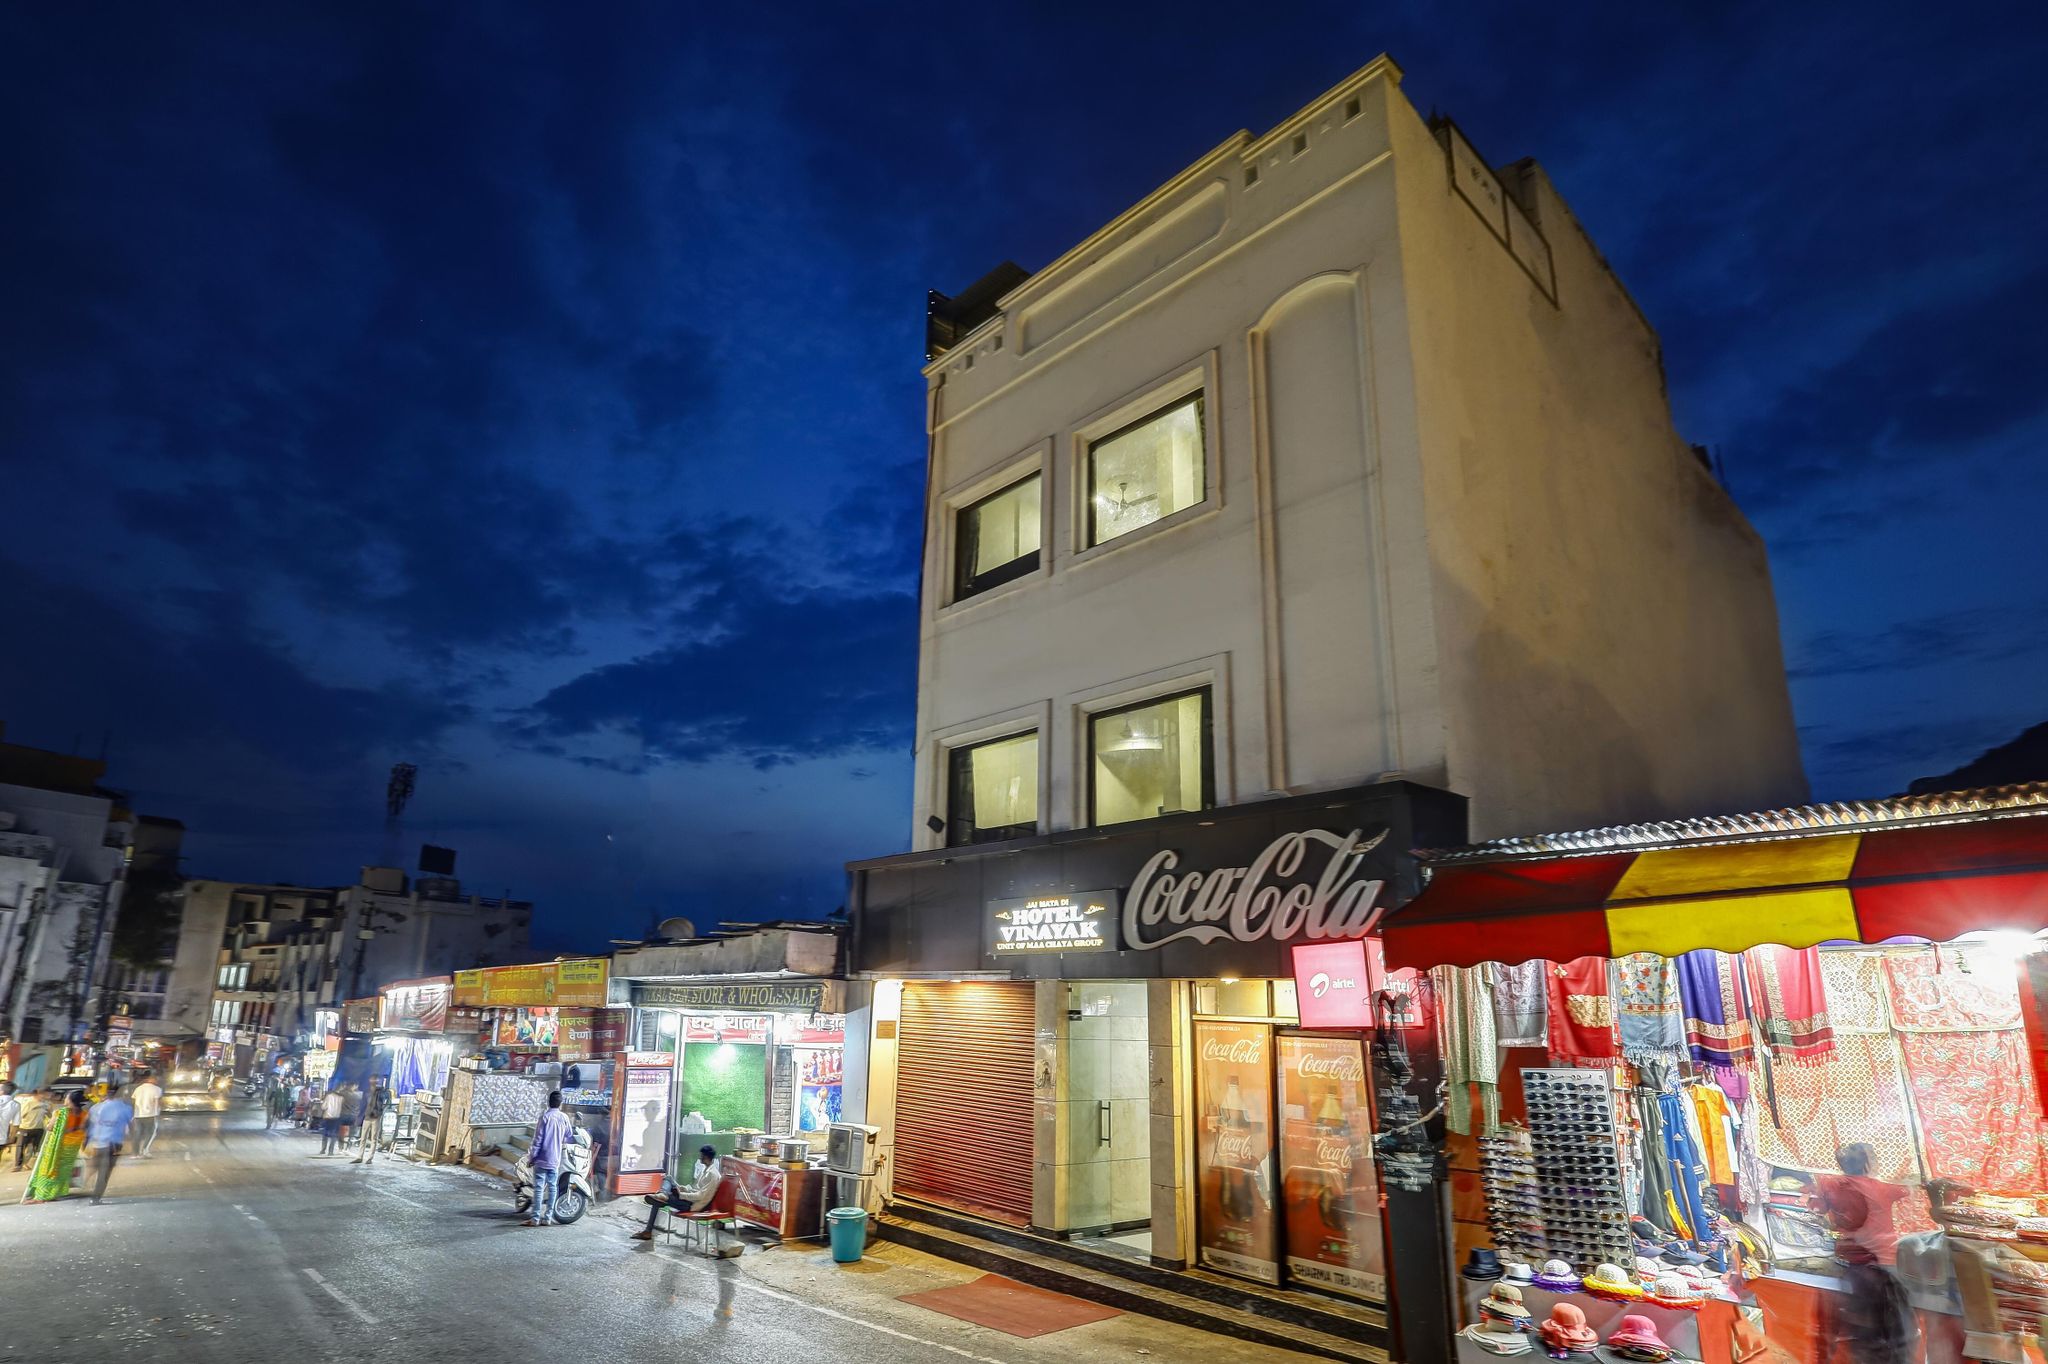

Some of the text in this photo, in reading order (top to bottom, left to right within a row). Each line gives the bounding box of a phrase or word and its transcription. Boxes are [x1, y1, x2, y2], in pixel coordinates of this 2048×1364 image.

[1026, 901, 1038, 909] JAI
[1039, 900, 1059, 908] MATA
[1012, 906, 1084, 926] HOTEL
[1000, 921, 1098, 942] VINAYAK
[1016, 942, 1026, 950] OF
[1027, 941, 1045, 949] MAA
[1045, 940, 1073, 948] CHAYA
[1074, 939, 1103, 947] GROUP
[1332, 978, 1356, 990] airtel
[728, 986, 736, 1004] &
[738, 986, 821, 1007] WHOLESALE
[1293, 1263, 1332, 1283] SHARMA
[1334, 1272, 1376, 1293] TRADING
